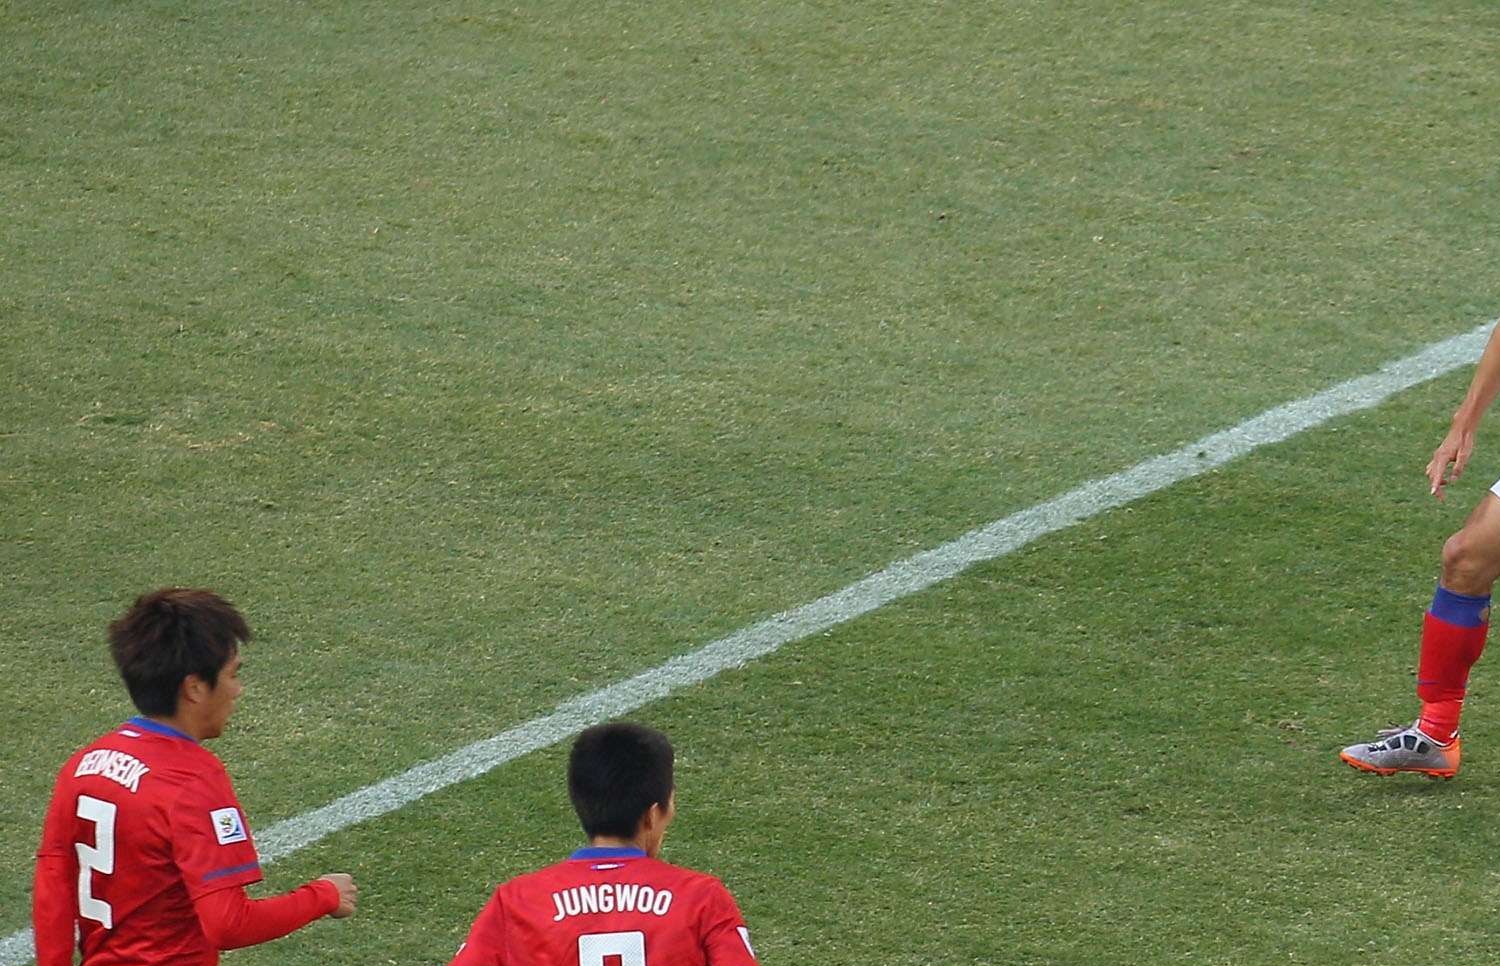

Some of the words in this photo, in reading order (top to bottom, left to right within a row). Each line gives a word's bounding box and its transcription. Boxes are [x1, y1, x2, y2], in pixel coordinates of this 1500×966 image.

[73, 749, 151, 793] BEOMSEOK
[74, 794, 118, 930] 2
[552, 883, 673, 922] JUNGWOO
